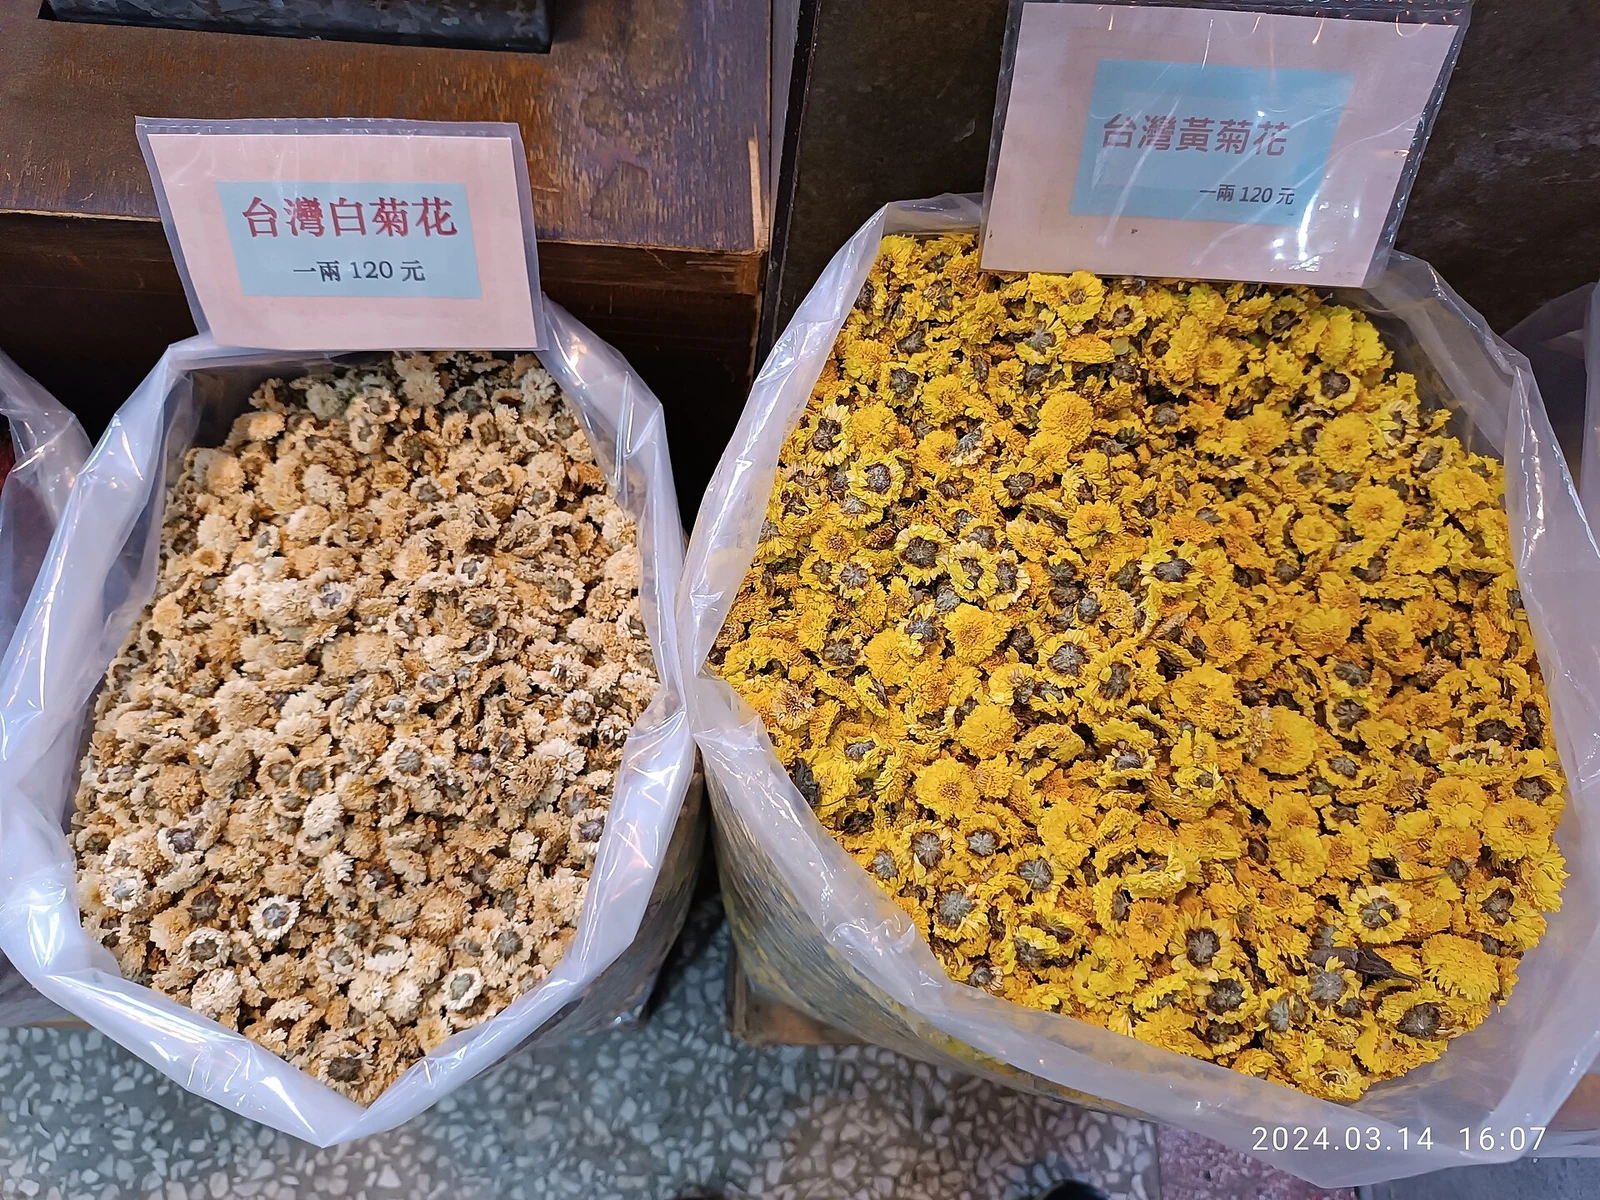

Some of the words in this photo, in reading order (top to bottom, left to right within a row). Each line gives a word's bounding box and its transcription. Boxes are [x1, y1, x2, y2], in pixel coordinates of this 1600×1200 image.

[1102, 113, 1289, 156] 台灣黃菊花
[1199, 184, 1235, 202] 一兩
[1239, 186, 1273, 203] 120
[1276, 187, 1295, 205] 元
[242, 196, 458, 238] 台灣白菊花
[293, 260, 341, 282] 一兩
[350, 260, 393, 279] 120
[400, 260, 426, 282] 元
